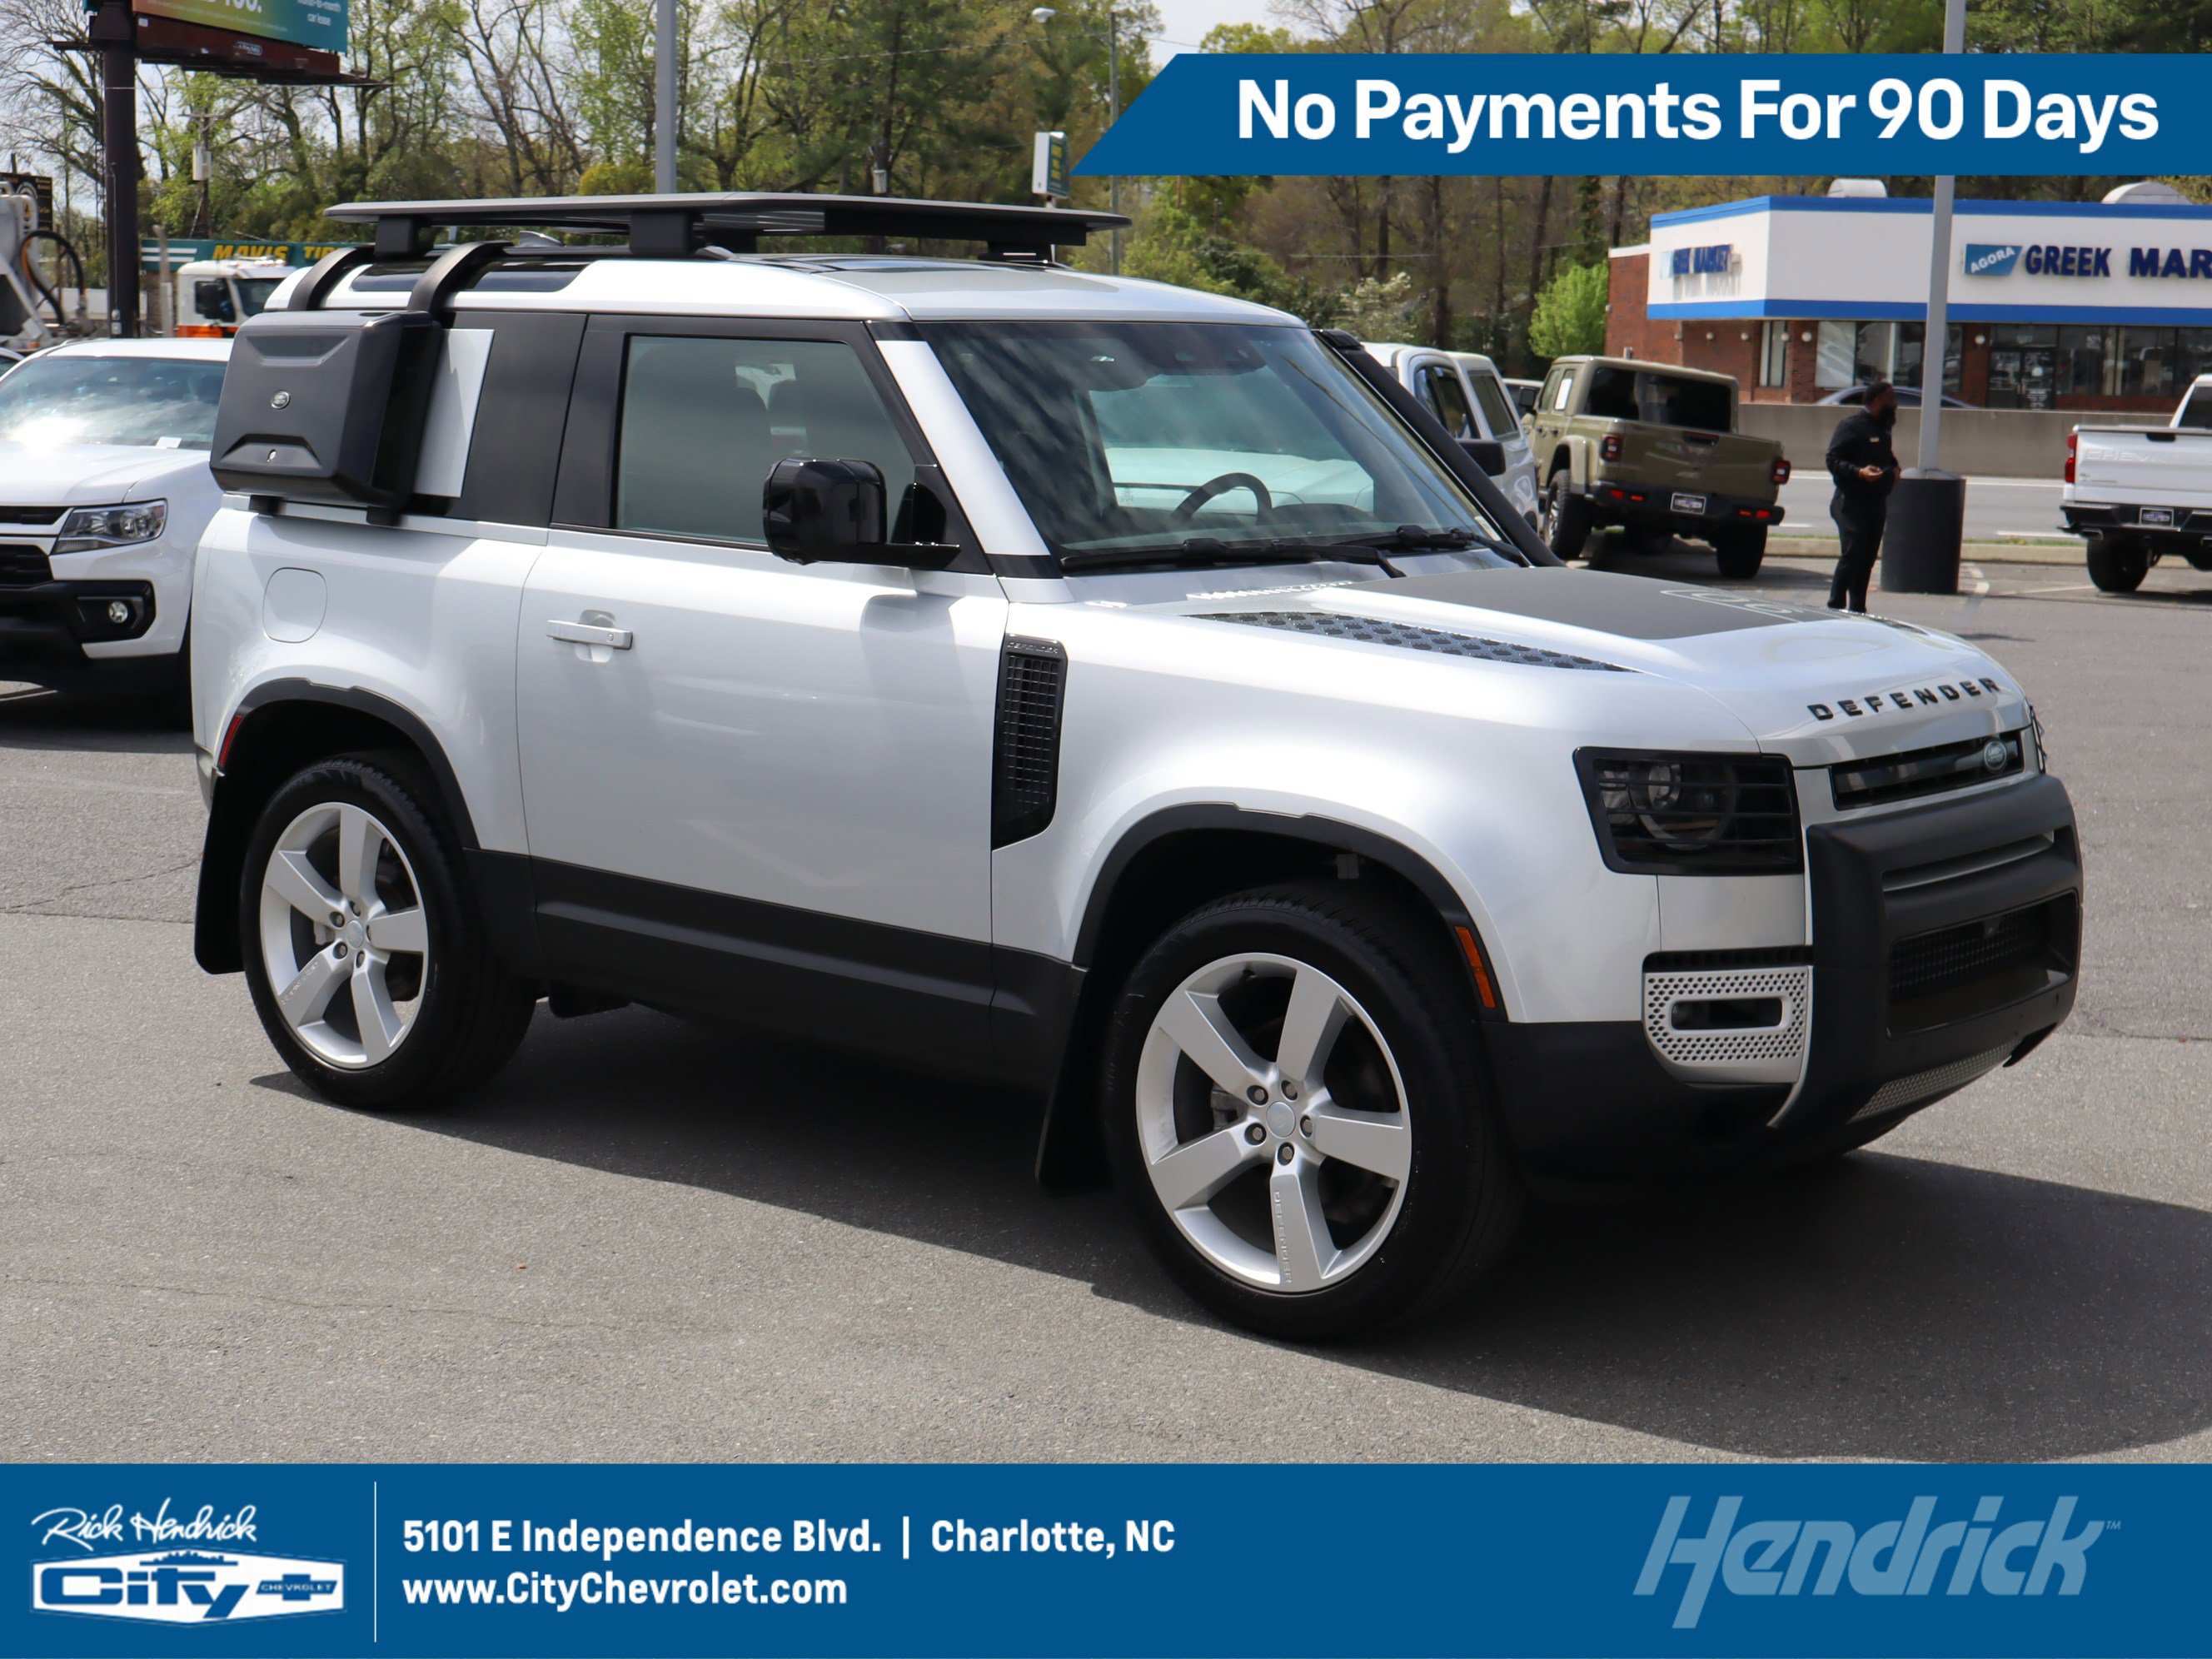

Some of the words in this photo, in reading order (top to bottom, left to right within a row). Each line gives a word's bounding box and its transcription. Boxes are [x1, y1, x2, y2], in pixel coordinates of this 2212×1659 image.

[212, 244, 289, 261] MAVIS
[1970, 246, 2016, 274] AGORA
[2025, 245, 2112, 277] GREEK
[1806, 677, 2000, 720] DEFENDER
